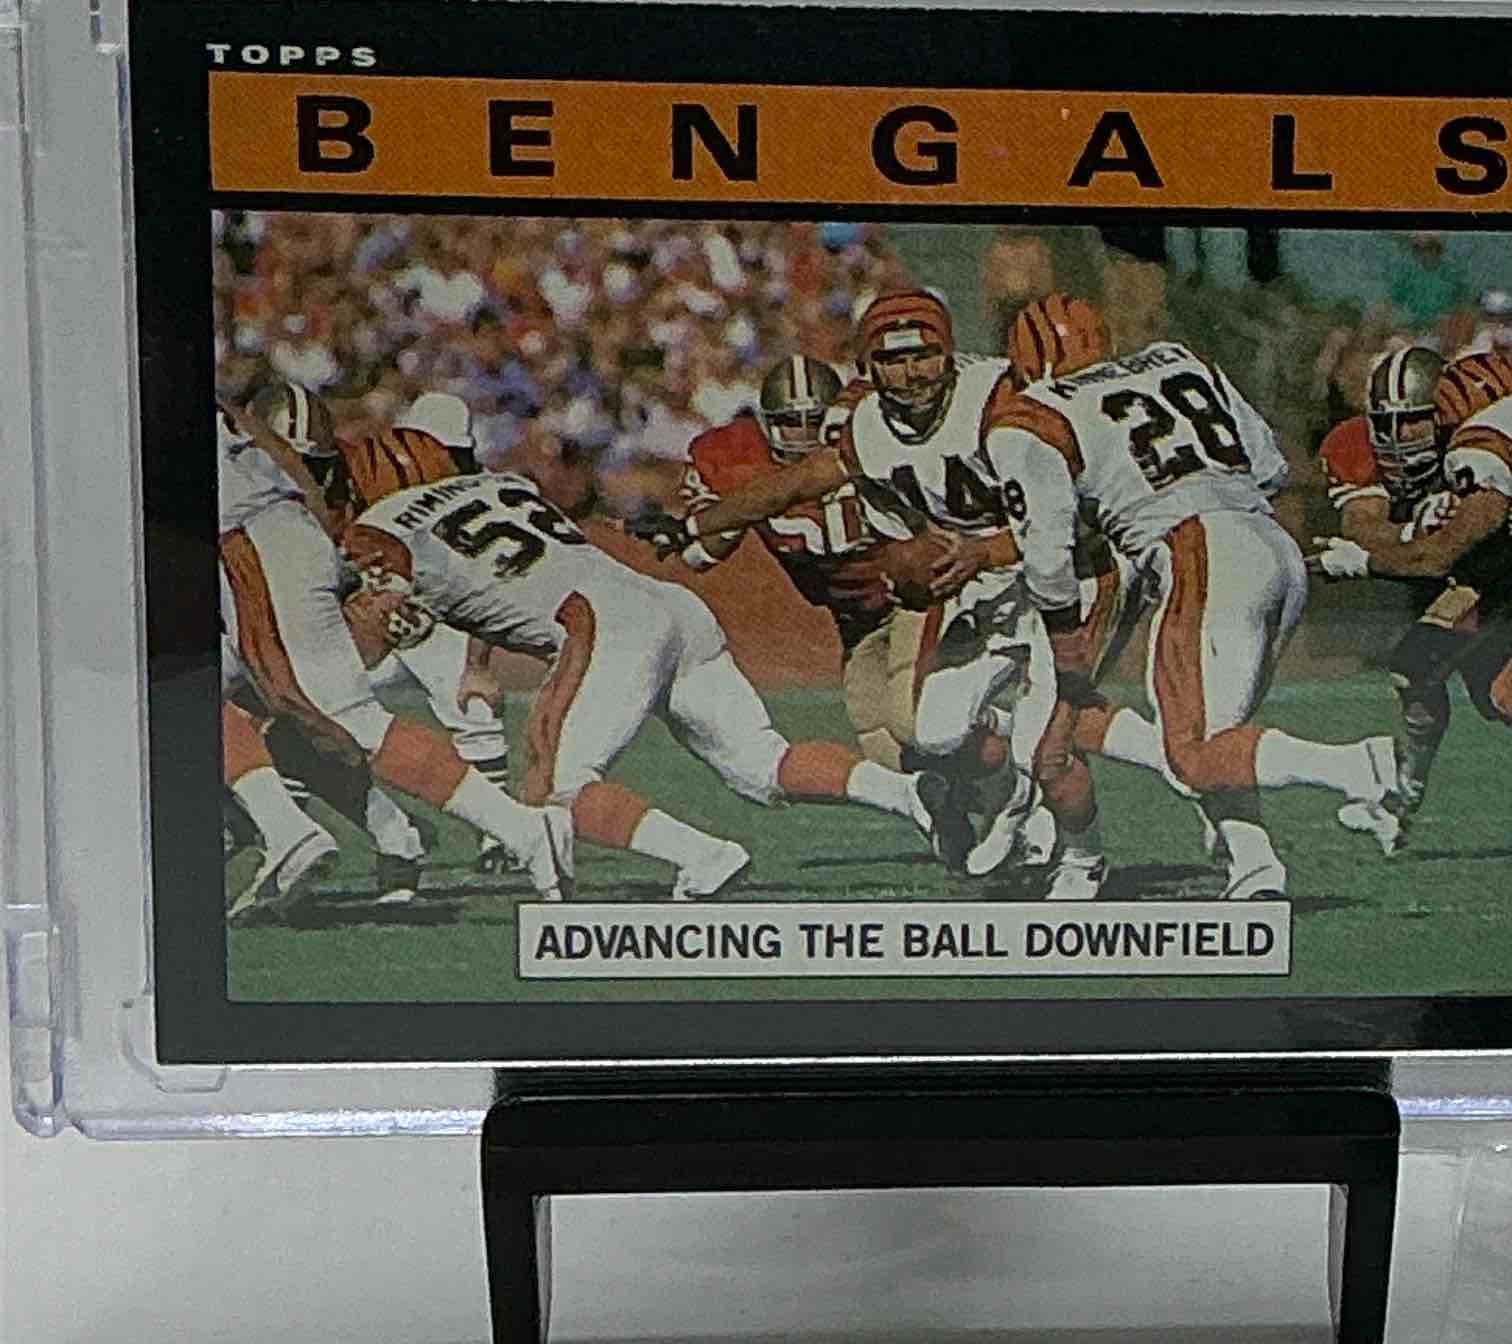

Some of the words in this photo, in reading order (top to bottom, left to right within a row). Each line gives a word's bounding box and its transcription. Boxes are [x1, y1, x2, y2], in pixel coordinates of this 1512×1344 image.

[205, 43, 377, 68] TOPPS
[295, 94, 1510, 196] BENGALS
[1100, 371, 1251, 492] 28
[890, 454, 1005, 521] 14
[534, 924, 782, 960] ADVANCING
[799, 923, 885, 959] THE
[903, 922, 1009, 959] BALL
[1025, 921, 1275, 958] DOWNFIELD
